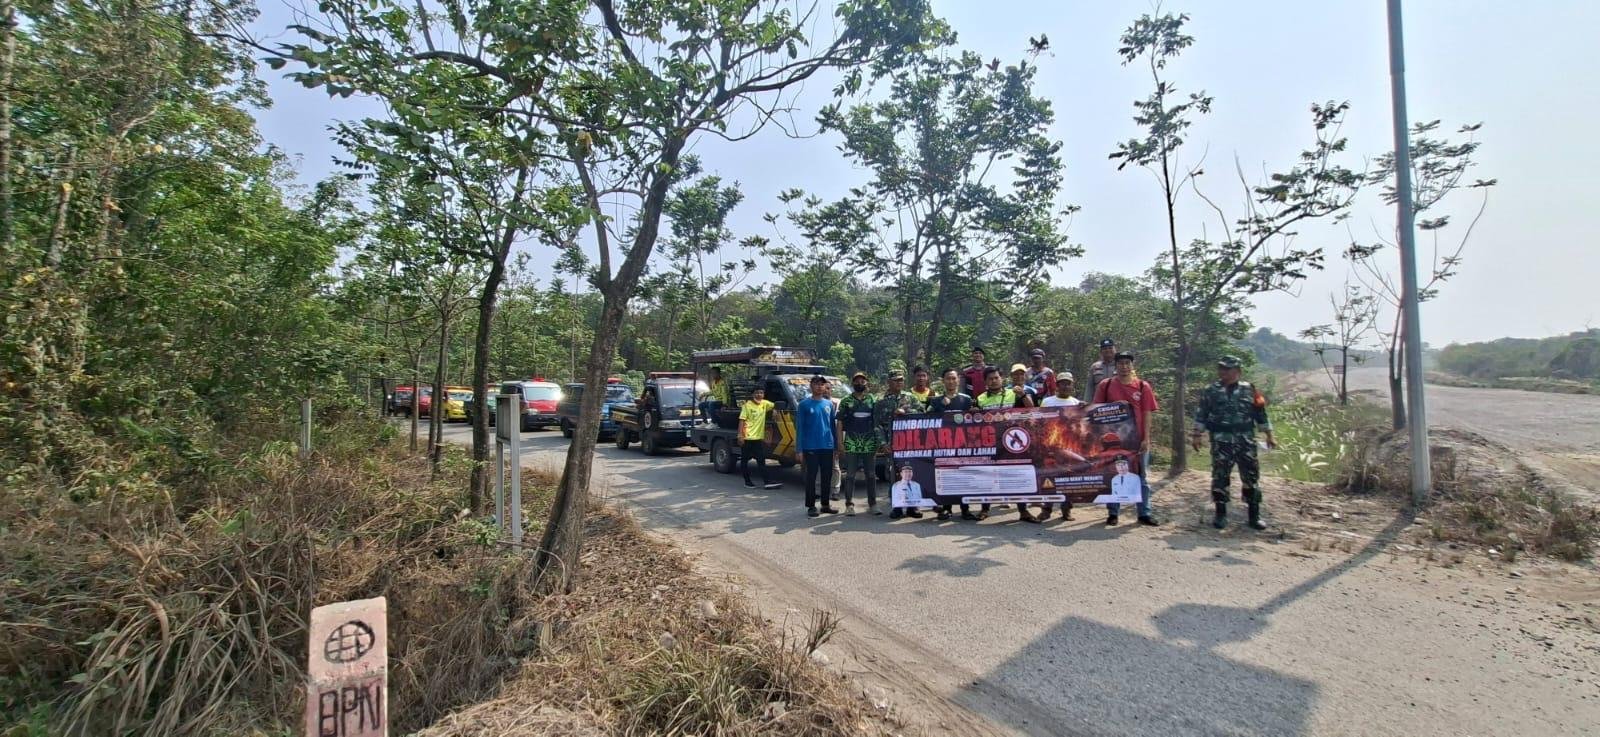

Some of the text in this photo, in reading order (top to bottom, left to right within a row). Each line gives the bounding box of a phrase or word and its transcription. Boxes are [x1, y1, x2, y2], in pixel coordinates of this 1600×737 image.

[892, 418, 942, 430] HIMBAUAN
[892, 425, 997, 450] DILARANG
[934, 449, 956, 457] HUTAN
[957, 448, 972, 456] DAN
[973, 447, 997, 455] LAHAN
[319, 685, 380, 737] BPN
